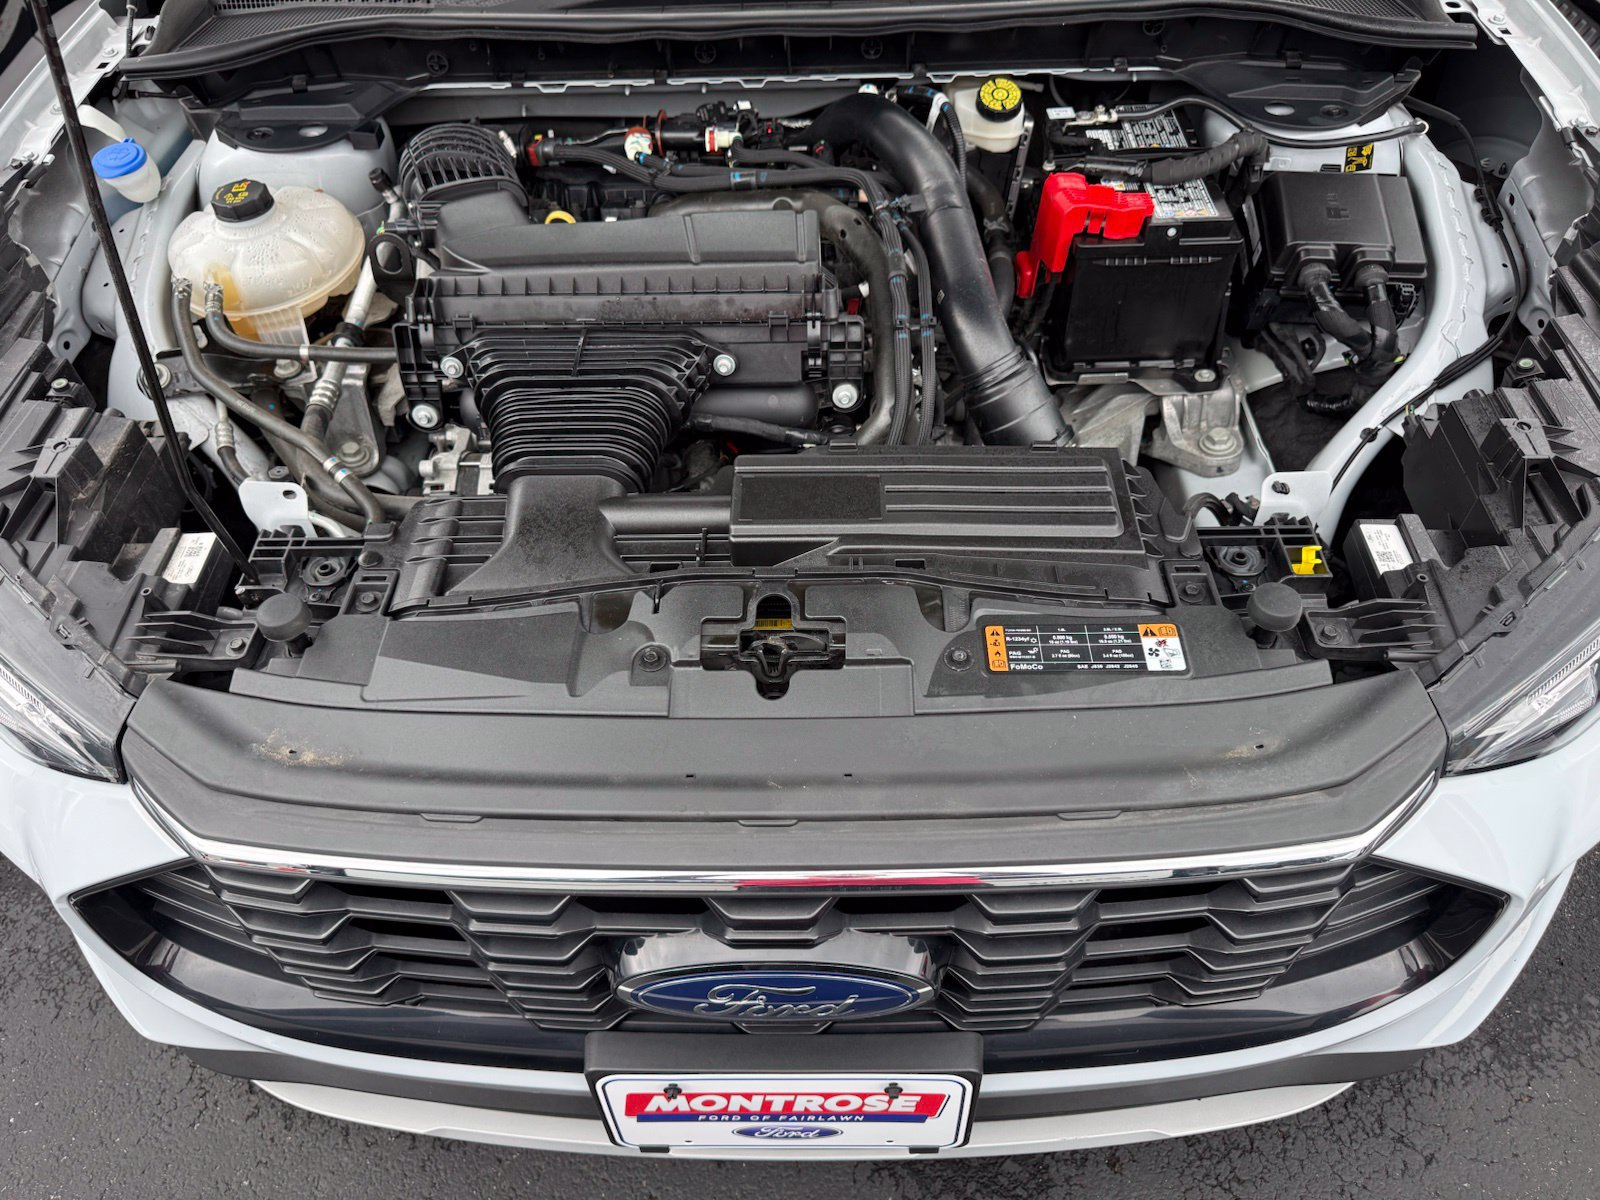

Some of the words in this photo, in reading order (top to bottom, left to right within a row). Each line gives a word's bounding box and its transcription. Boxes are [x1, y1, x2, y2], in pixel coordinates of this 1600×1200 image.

[693, 983, 860, 1018] Ford
[644, 1094, 922, 1112] MONTROSE
[754, 1126, 821, 1138] Ford
